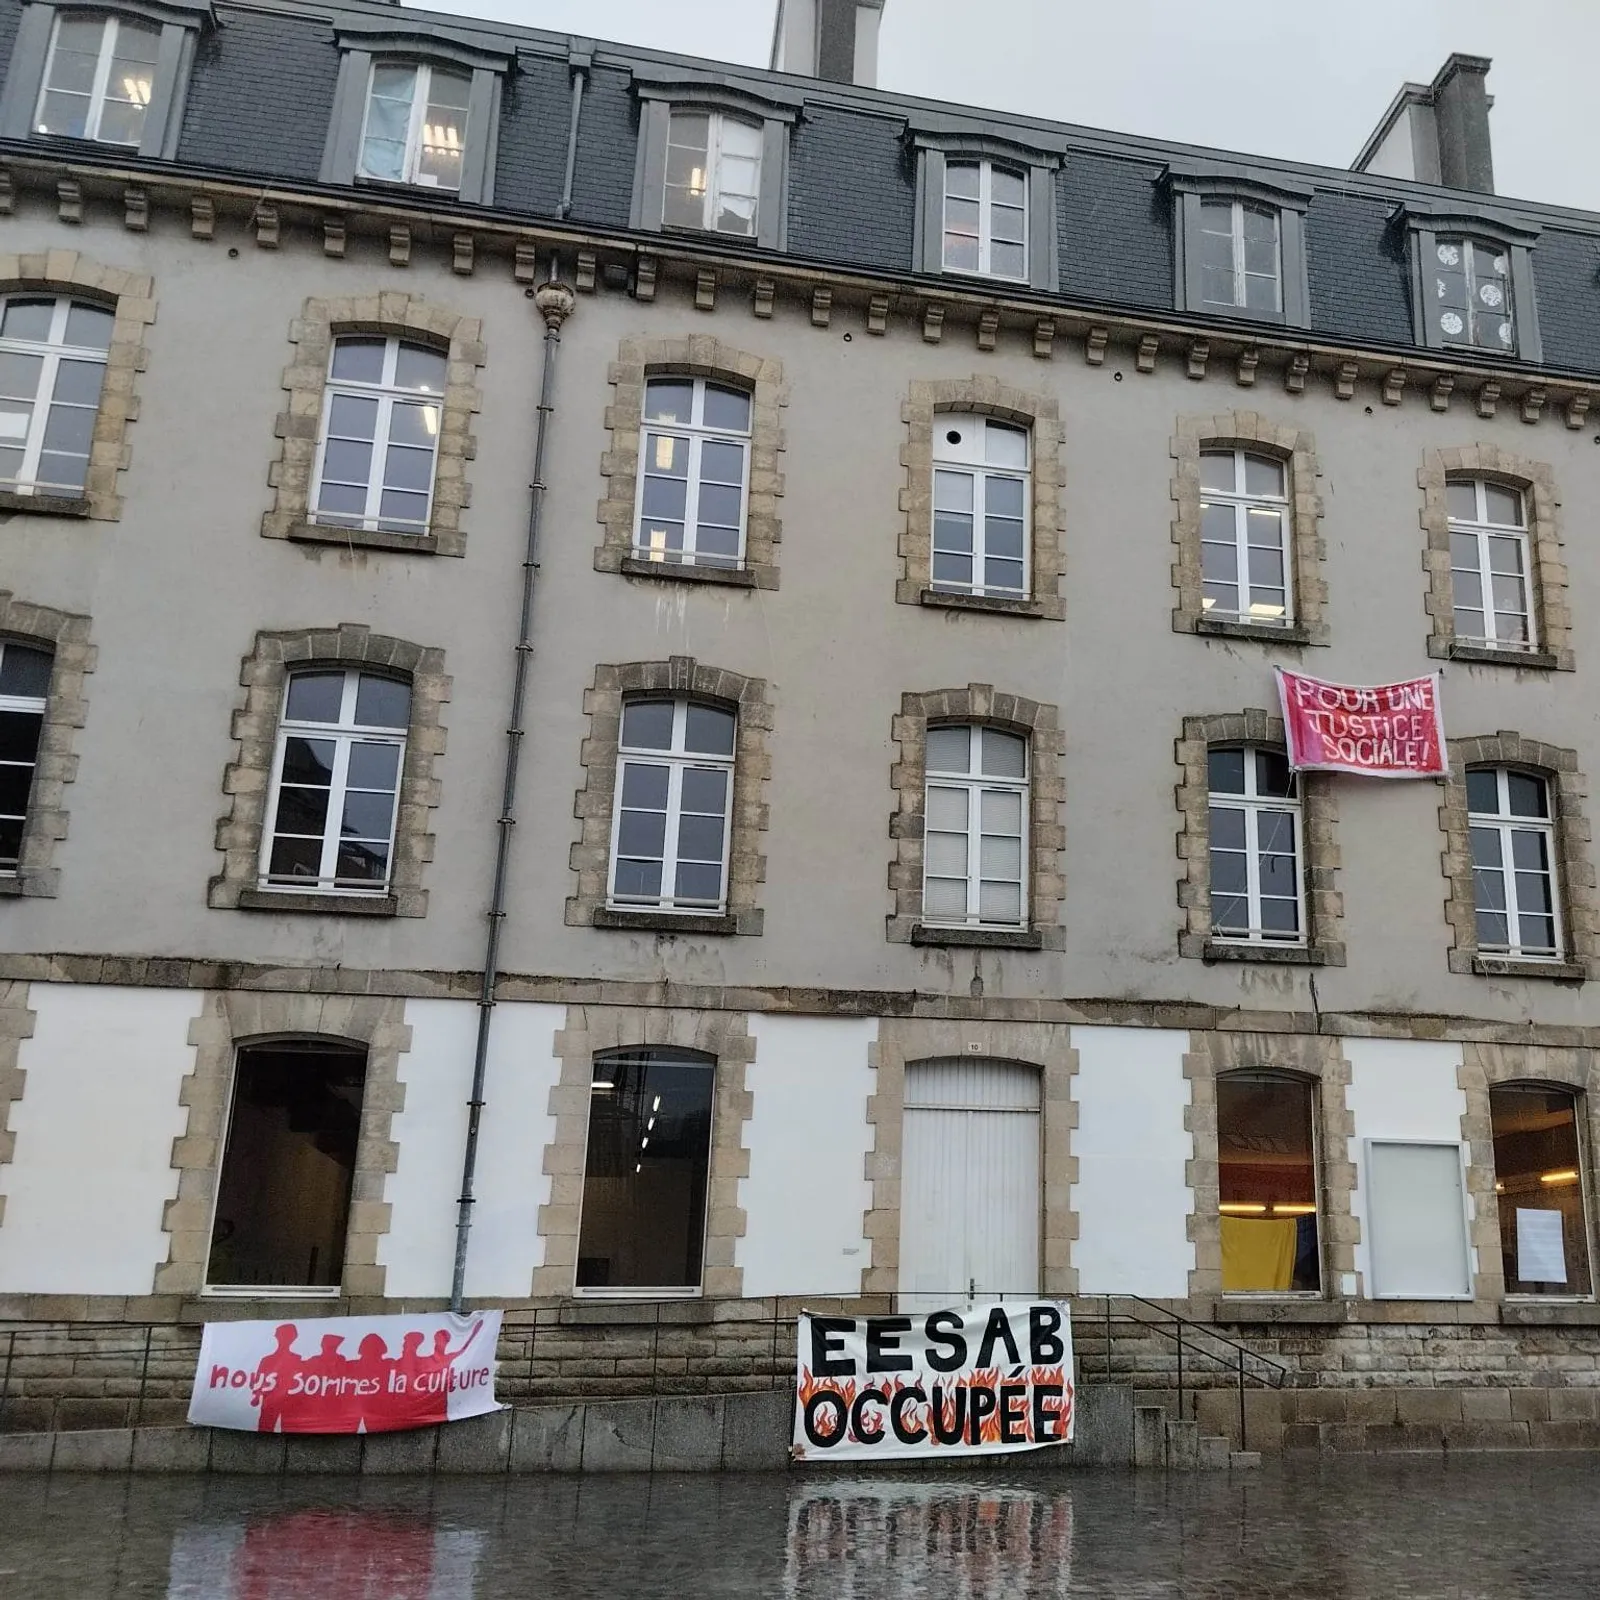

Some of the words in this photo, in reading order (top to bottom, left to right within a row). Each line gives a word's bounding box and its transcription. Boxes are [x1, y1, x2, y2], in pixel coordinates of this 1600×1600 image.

[1295, 679, 1381, 713] POUR
[1386, 681, 1433, 712] UNE
[810, 1306, 1064, 1377] EESAB
[209, 1364, 278, 1393] nous
[387, 1369, 407, 1393] la
[413, 1367, 490, 1393] culture
[804, 1365, 1064, 1448] OCCUPÉE
